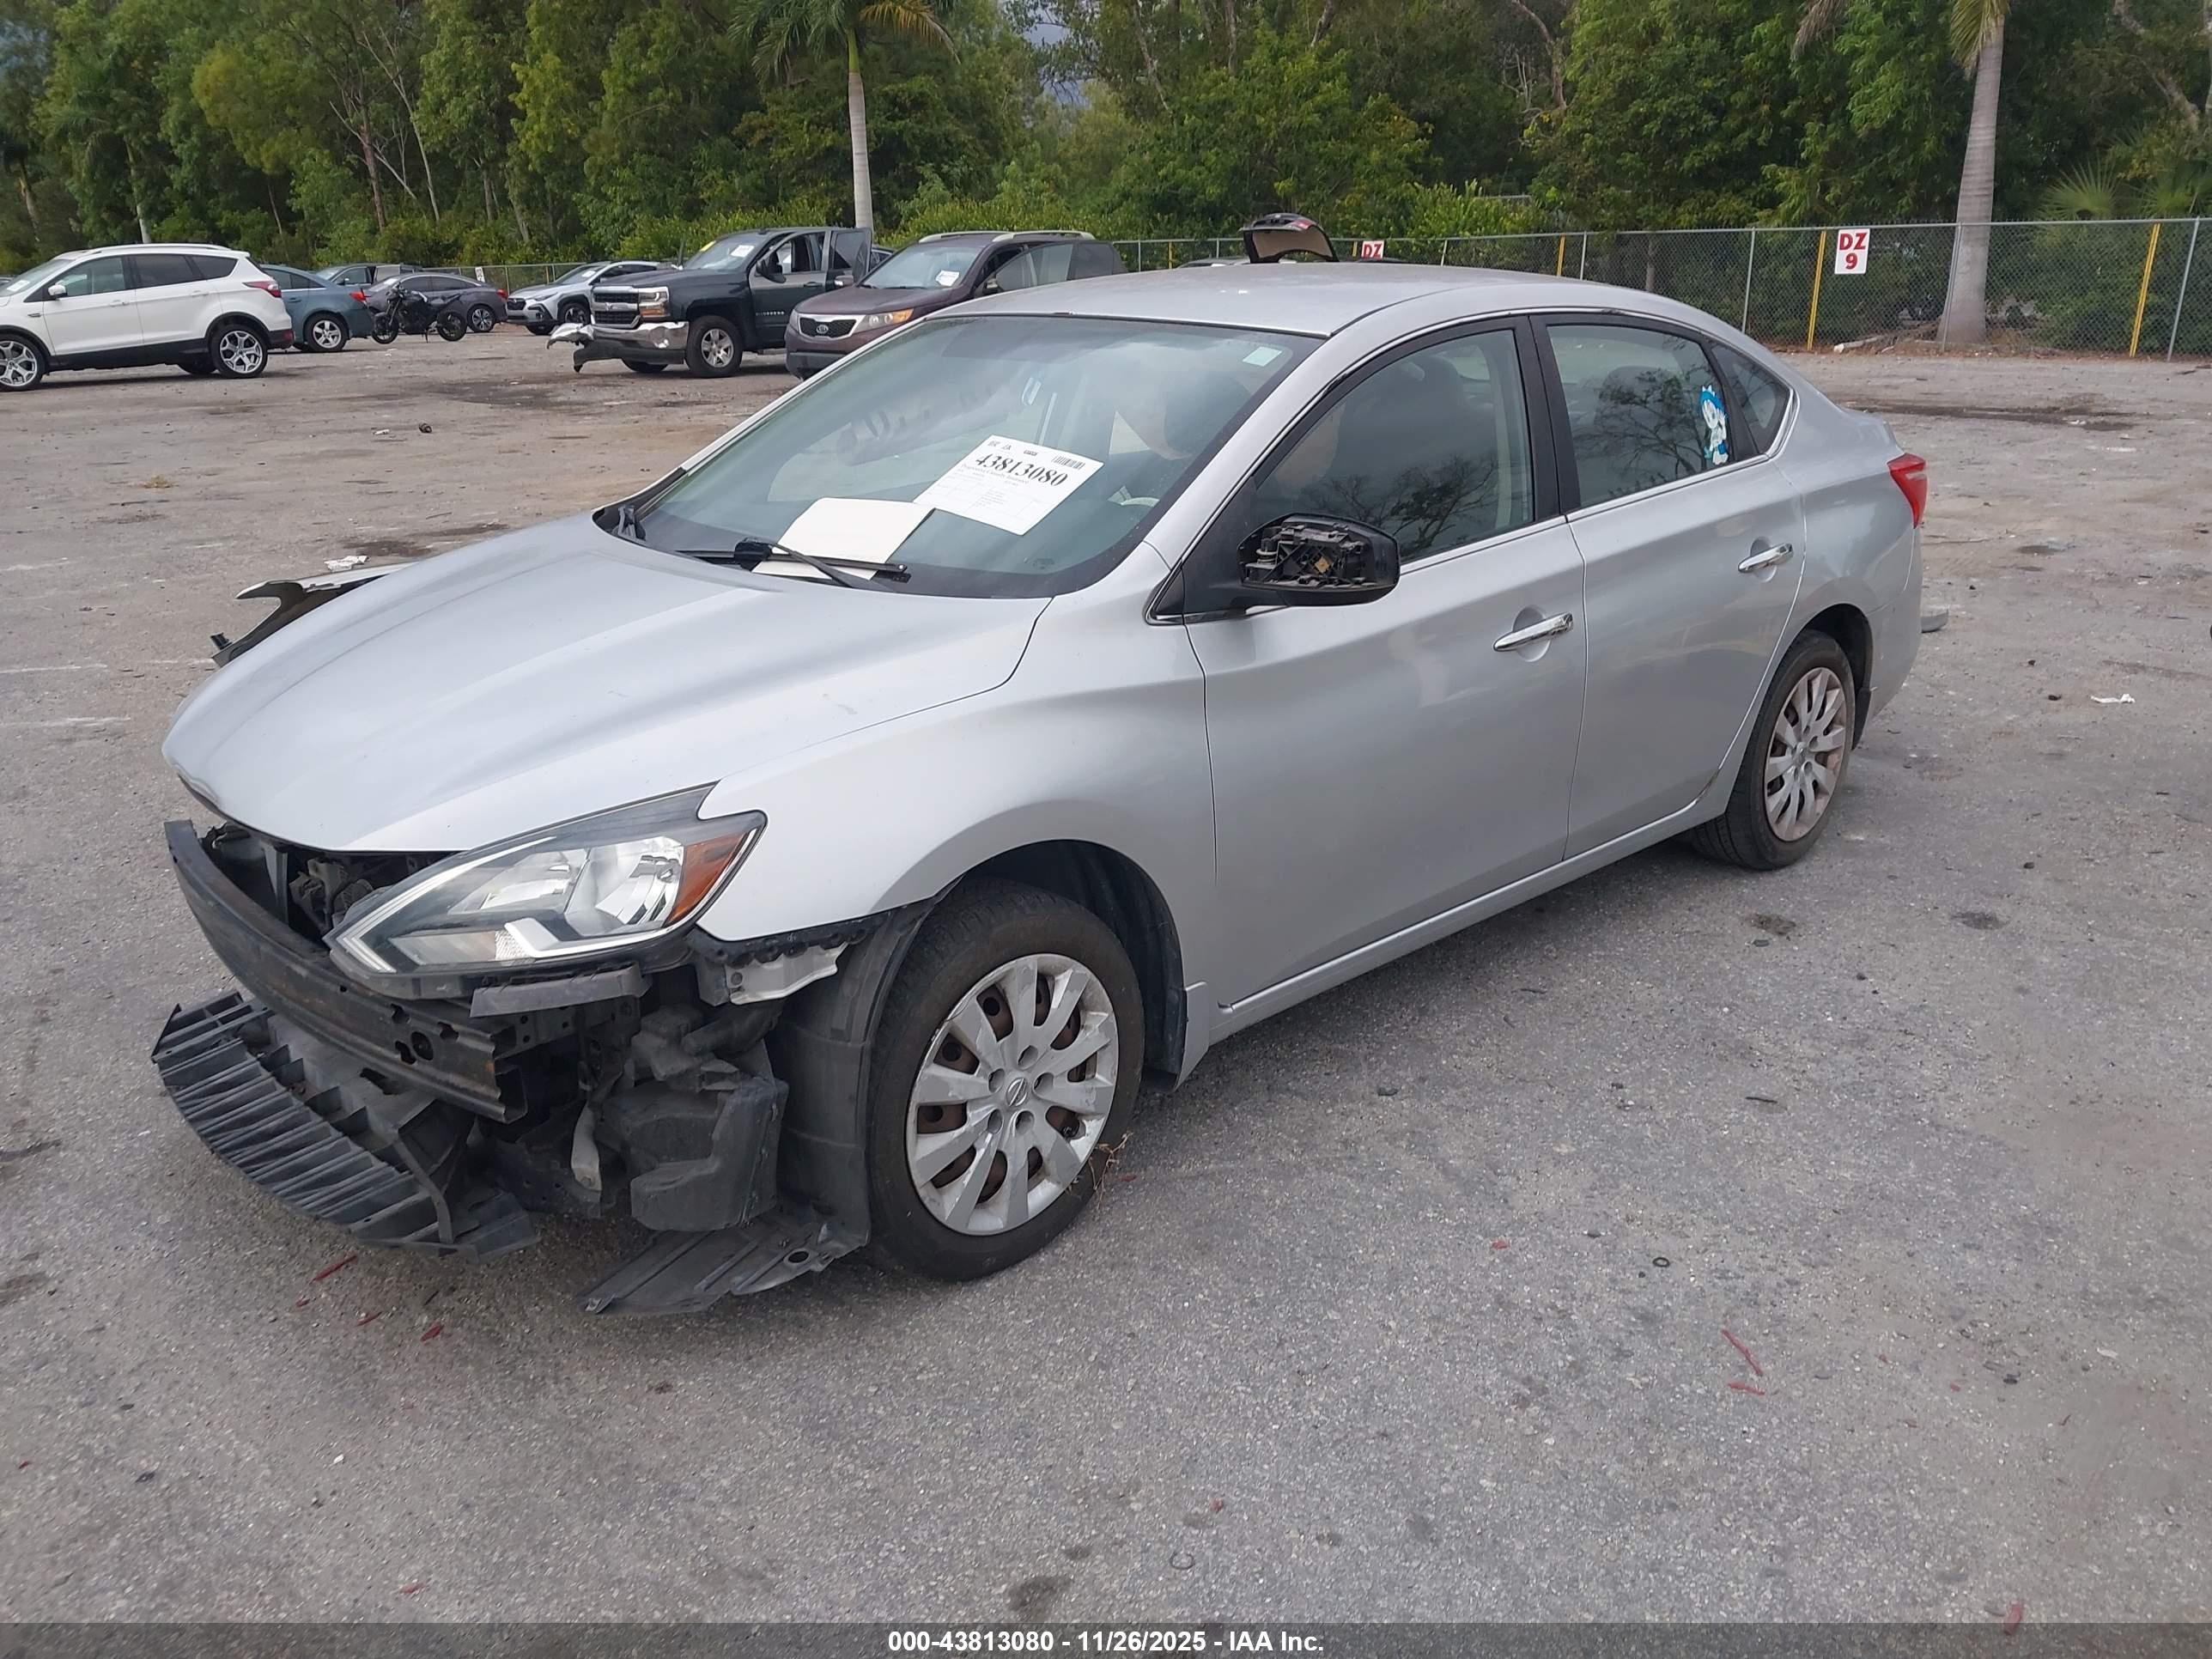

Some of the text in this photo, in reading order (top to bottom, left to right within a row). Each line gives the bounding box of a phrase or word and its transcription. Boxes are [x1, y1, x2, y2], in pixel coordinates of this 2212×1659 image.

[1839, 232, 1868, 251] DZ
[1364, 243, 1382, 259] DZ
[1845, 252, 1858, 270] 9
[975, 453, 1068, 486] 43813080
